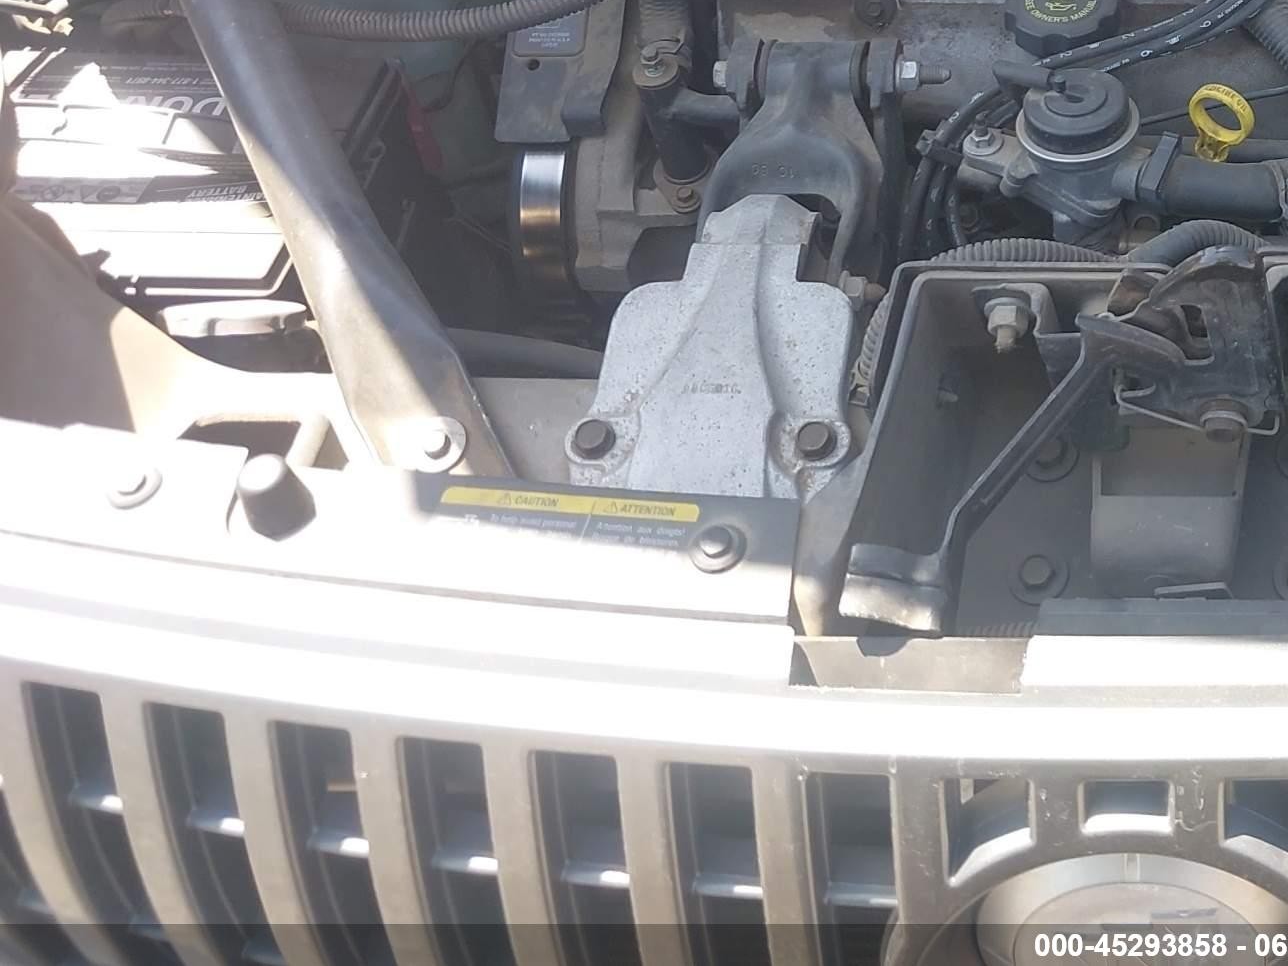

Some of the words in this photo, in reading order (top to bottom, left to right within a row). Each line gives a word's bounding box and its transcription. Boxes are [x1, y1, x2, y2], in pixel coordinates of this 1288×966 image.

[188, 185, 248, 199] BATTERY
[513, 496, 560, 508] CAUTION
[620, 505, 677, 517] ATTENTION
